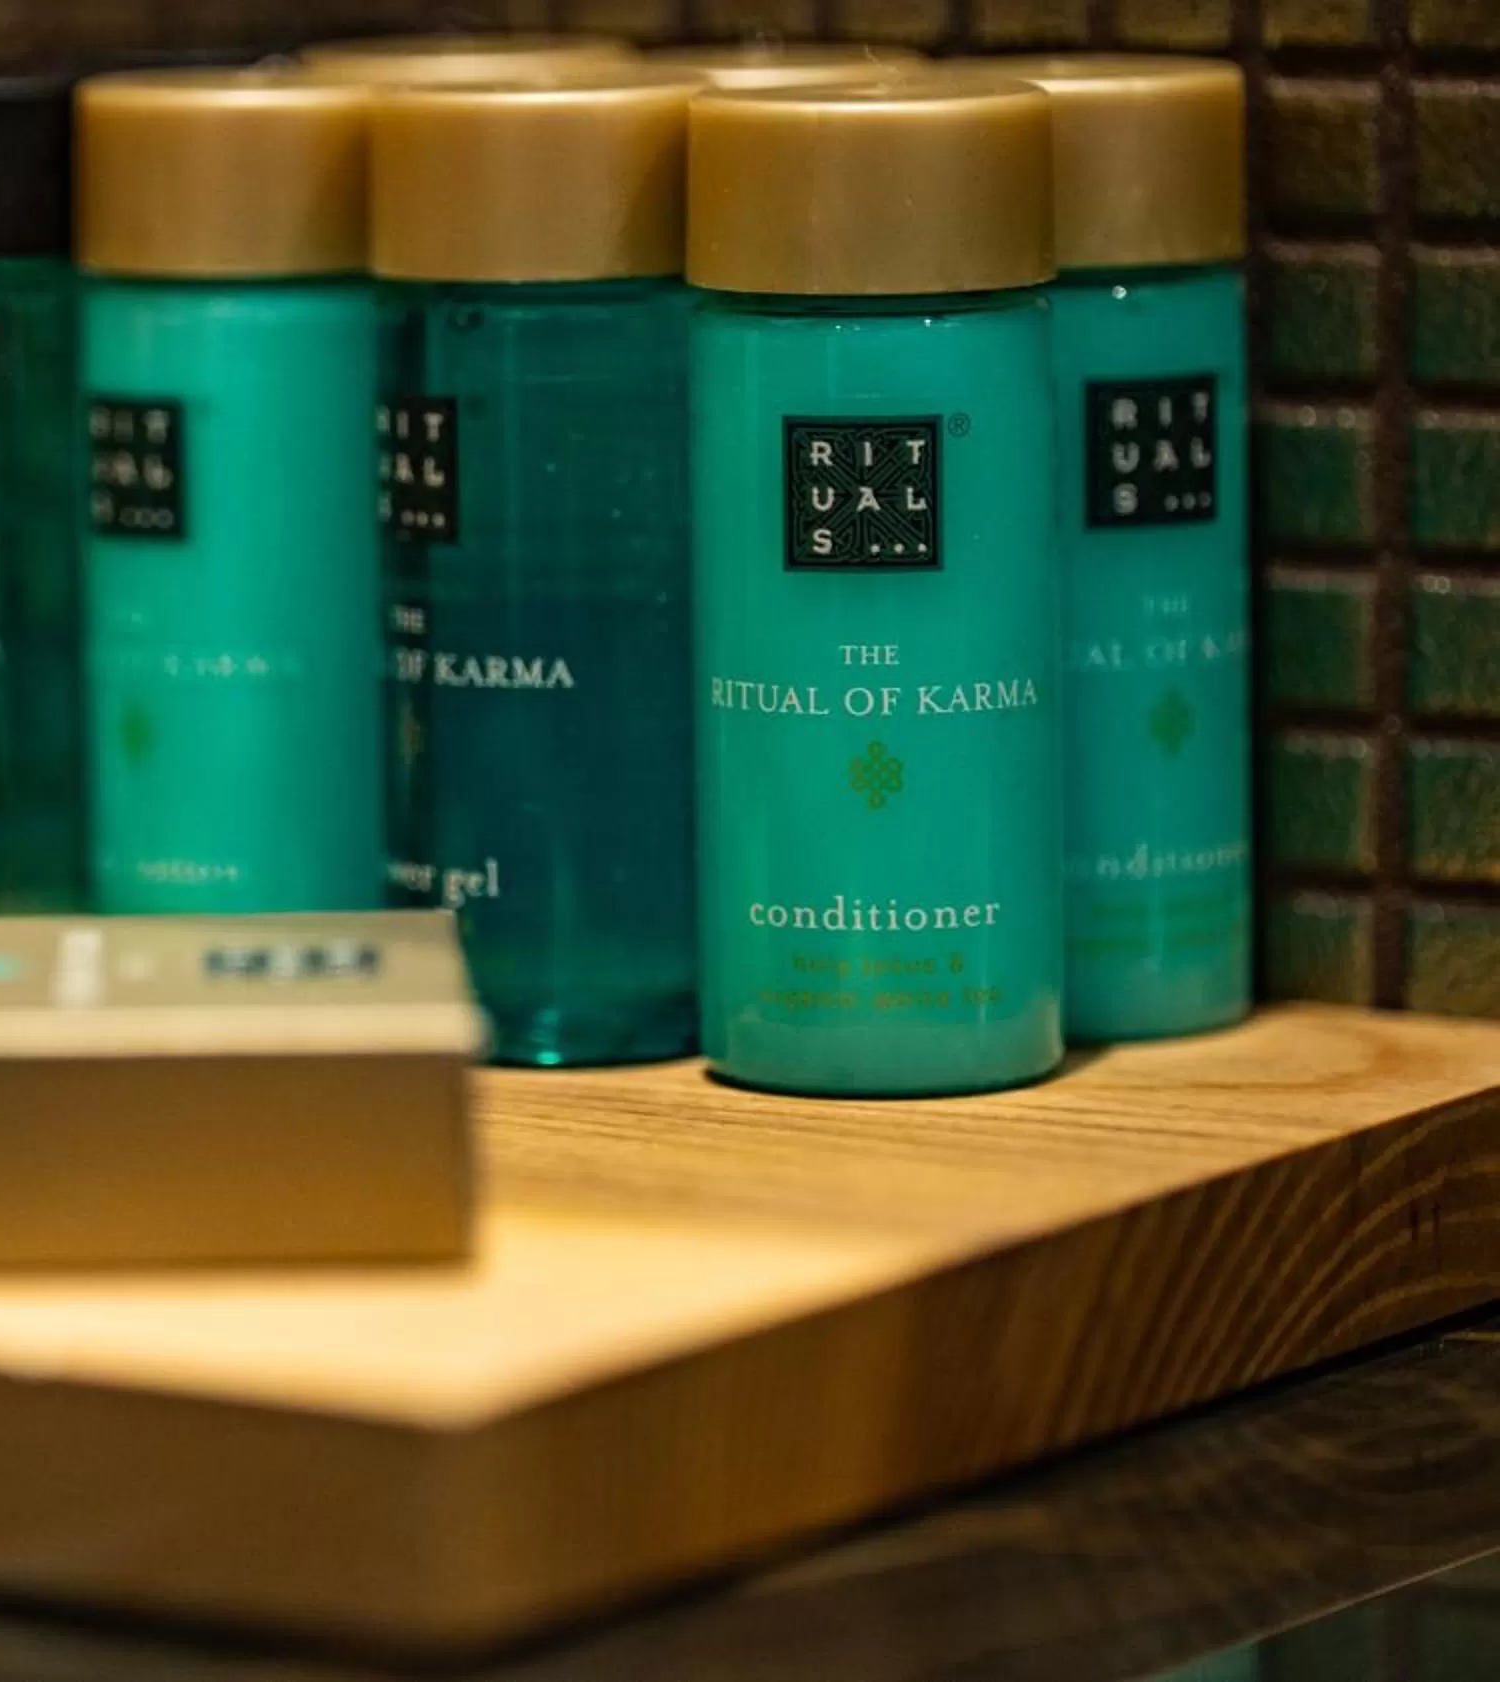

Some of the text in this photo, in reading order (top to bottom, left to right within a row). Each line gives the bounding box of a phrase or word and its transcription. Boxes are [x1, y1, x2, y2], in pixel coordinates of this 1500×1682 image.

[1111, 389, 1209, 427] RIT
[810, 440, 926, 467] RIT
[1111, 433, 1211, 474] UAL
[811, 486, 928, 512] UAL
[434, 652, 575, 689] KARMA
[840, 645, 900, 665] THE
[711, 677, 1038, 716] RITUAL OF KARMA
[443, 856, 499, 910] gel
[749, 896, 1001, 932] conditioner
